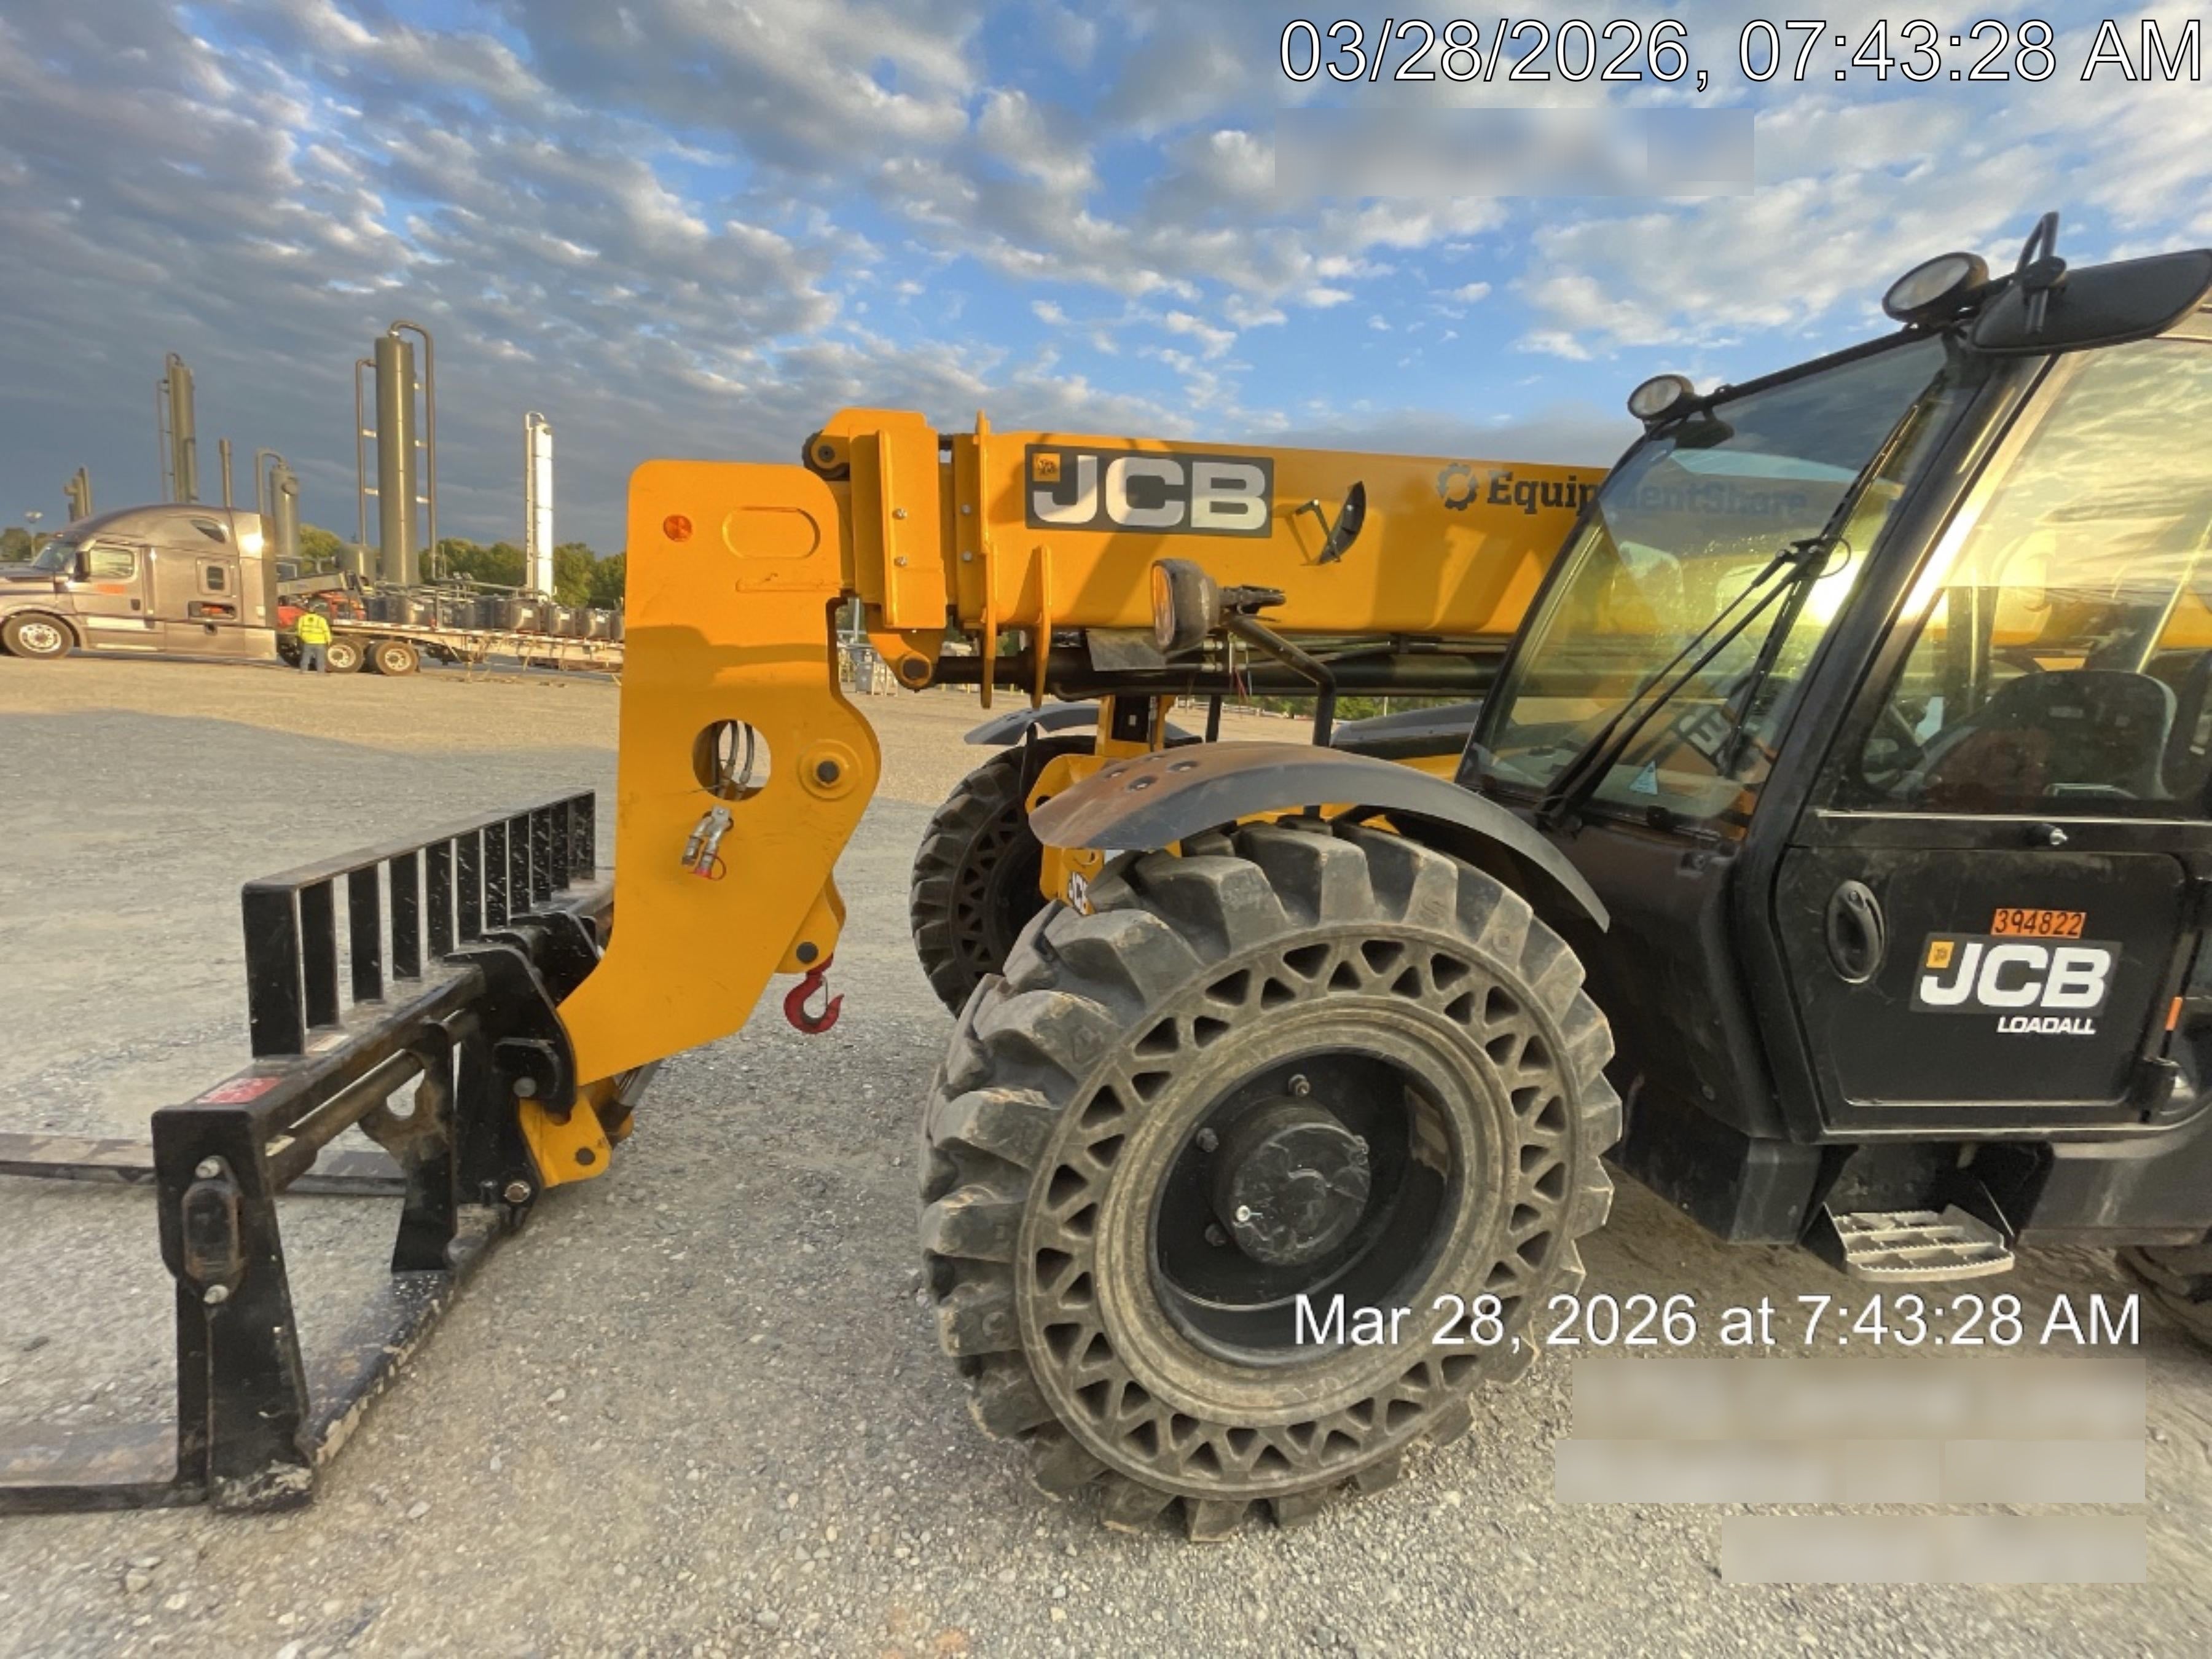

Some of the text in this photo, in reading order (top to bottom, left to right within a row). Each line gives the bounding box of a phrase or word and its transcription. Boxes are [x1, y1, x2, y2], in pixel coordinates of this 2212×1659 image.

[1033, 454, 1268, 530] JCB
[1994, 910, 2082, 936] 394822
[1920, 943, 2111, 1008] JCB
[1996, 1016, 2096, 1035] LOADALL
